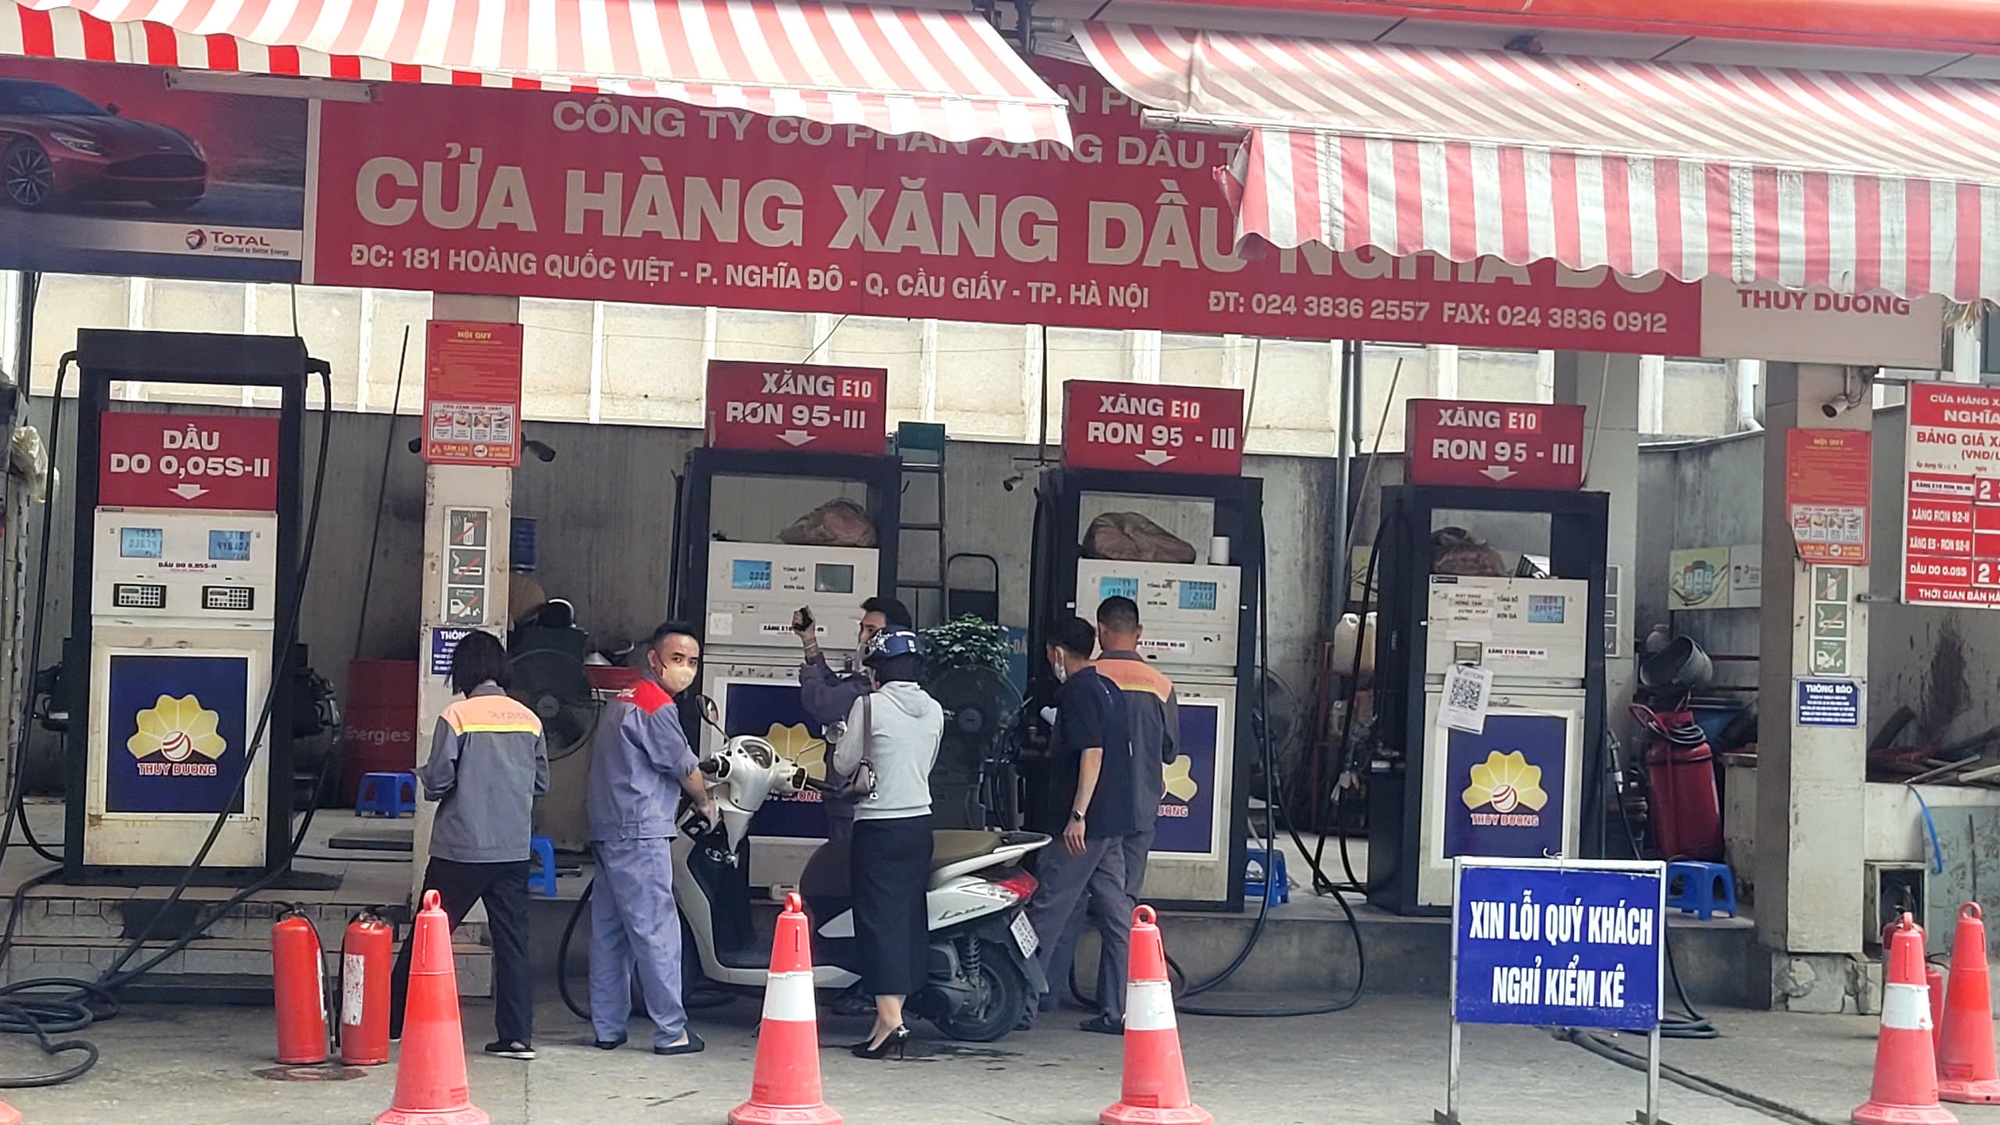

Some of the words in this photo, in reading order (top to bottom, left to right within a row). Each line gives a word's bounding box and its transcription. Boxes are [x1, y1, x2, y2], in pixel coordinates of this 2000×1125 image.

[553, 97, 686, 138] CÔNG
[700, 110, 754, 141] TY
[1118, 130, 1205, 169] DẦU
[356, 142, 536, 232] CỬA
[565, 156, 804, 248] HÀNG
[828, 177, 1058, 263] XĂNG
[1088, 179, 1247, 273] DẦU
[351, 244, 394, 268] ĐC:
[402, 247, 440, 271] 181
[448, 246, 537, 276] HOÀNG
[544, 249, 616, 280] QUỐC
[622, 257, 674, 287] VIỆT
[695, 263, 718, 286] P.
[726, 261, 801, 290] NGHĨA
[808, 264, 842, 292] ĐÔ
[865, 273, 889, 297] Q.
[896, 267, 946, 298] CẦU
[951, 271, 1006, 301] GIẤY
[1026, 282, 1061, 305] TP.
[1069, 279, 1102, 307] HÀ
[1108, 281, 1149, 313] NỘI
[1208, 291, 1244, 313] ĐT:
[1251, 294, 1296, 316] 024
[1304, 297, 1363, 318] 3836
[1370, 299, 1429, 322] 2557
[1442, 302, 1490, 325] FAX:
[1497, 305, 1541, 327] 024
[1548, 308, 1606, 330] 3836
[1613, 310, 1667, 333] 0912
[761, 370, 835, 397] XĂNG
[842, 380, 872, 398] E10
[726, 402, 783, 425] RON
[792, 405, 865, 429] 95-III
[1099, 394, 1164, 417] XĂNG
[1171, 400, 1200, 419] E10
[1438, 407, 1500, 428] XĂNG
[1508, 413, 1537, 430] E10
[163, 424, 219, 451] DẦU
[1087, 422, 1143, 445] RON
[1152, 426, 1183, 447] 95
[1212, 428, 1235, 450] III
[1916, 428, 1957, 445] BẢNG
[1961, 432, 1985, 447] GIÁ
[1432, 438, 1486, 460] RON
[1494, 442, 1527, 463] 95
[1553, 444, 1574, 465] III
[110, 453, 151, 474] DO
[159, 456, 270, 479] 0,05S-II
[1805, 683, 1834, 694] THÔNG
[137, 762, 172, 776] THUY
[1470, 813, 1501, 826] THUY
[1469, 901, 1504, 940] XIN
[1509, 890, 1540, 941] LỖI
[1545, 898, 1584, 946] QUÝ
[1588, 900, 1653, 946] KHÁCH
[1492, 955, 1542, 1005] NGHỈ
[1545, 954, 1595, 1007] KIỂM
[1600, 963, 1625, 1008] KÊ
